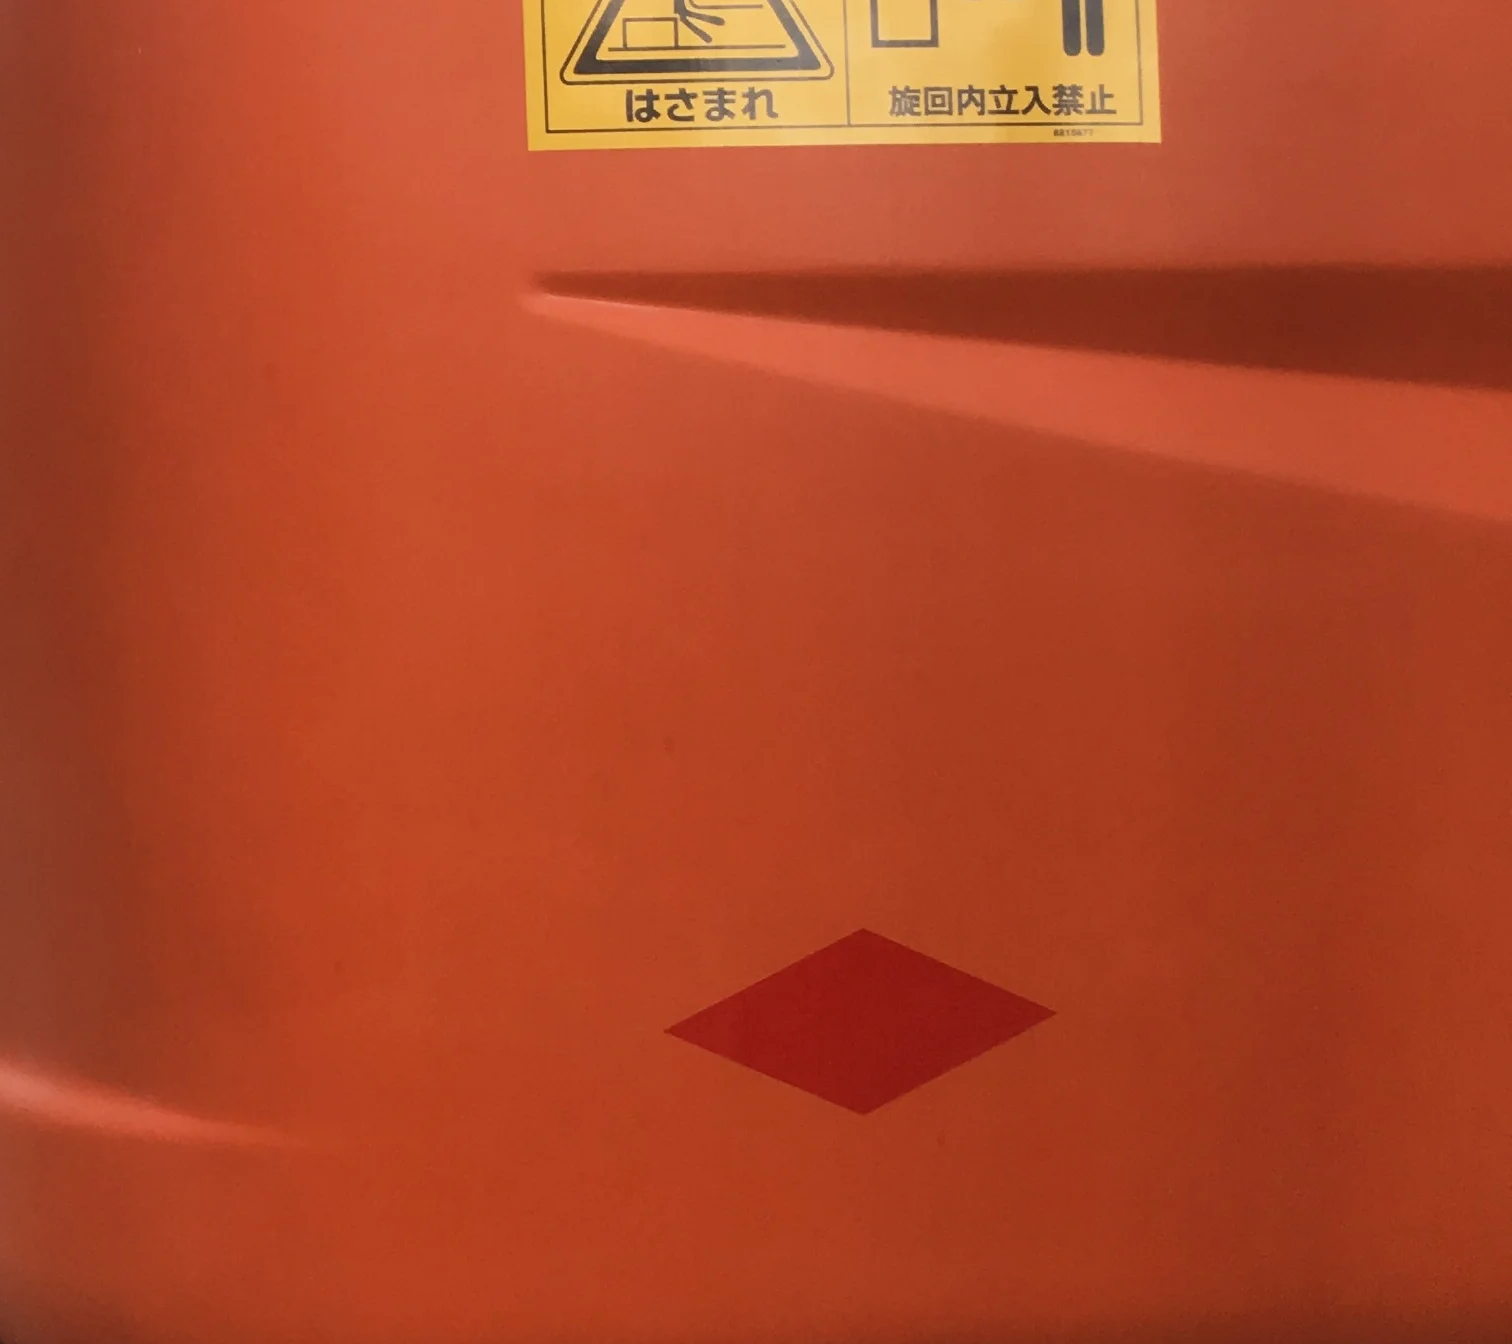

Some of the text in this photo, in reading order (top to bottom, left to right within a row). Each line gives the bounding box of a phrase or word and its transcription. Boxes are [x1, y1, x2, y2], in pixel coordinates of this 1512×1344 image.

[625, 86, 779, 123] はさまれ
[888, 84, 1117, 117] 旋回内立入禁止
